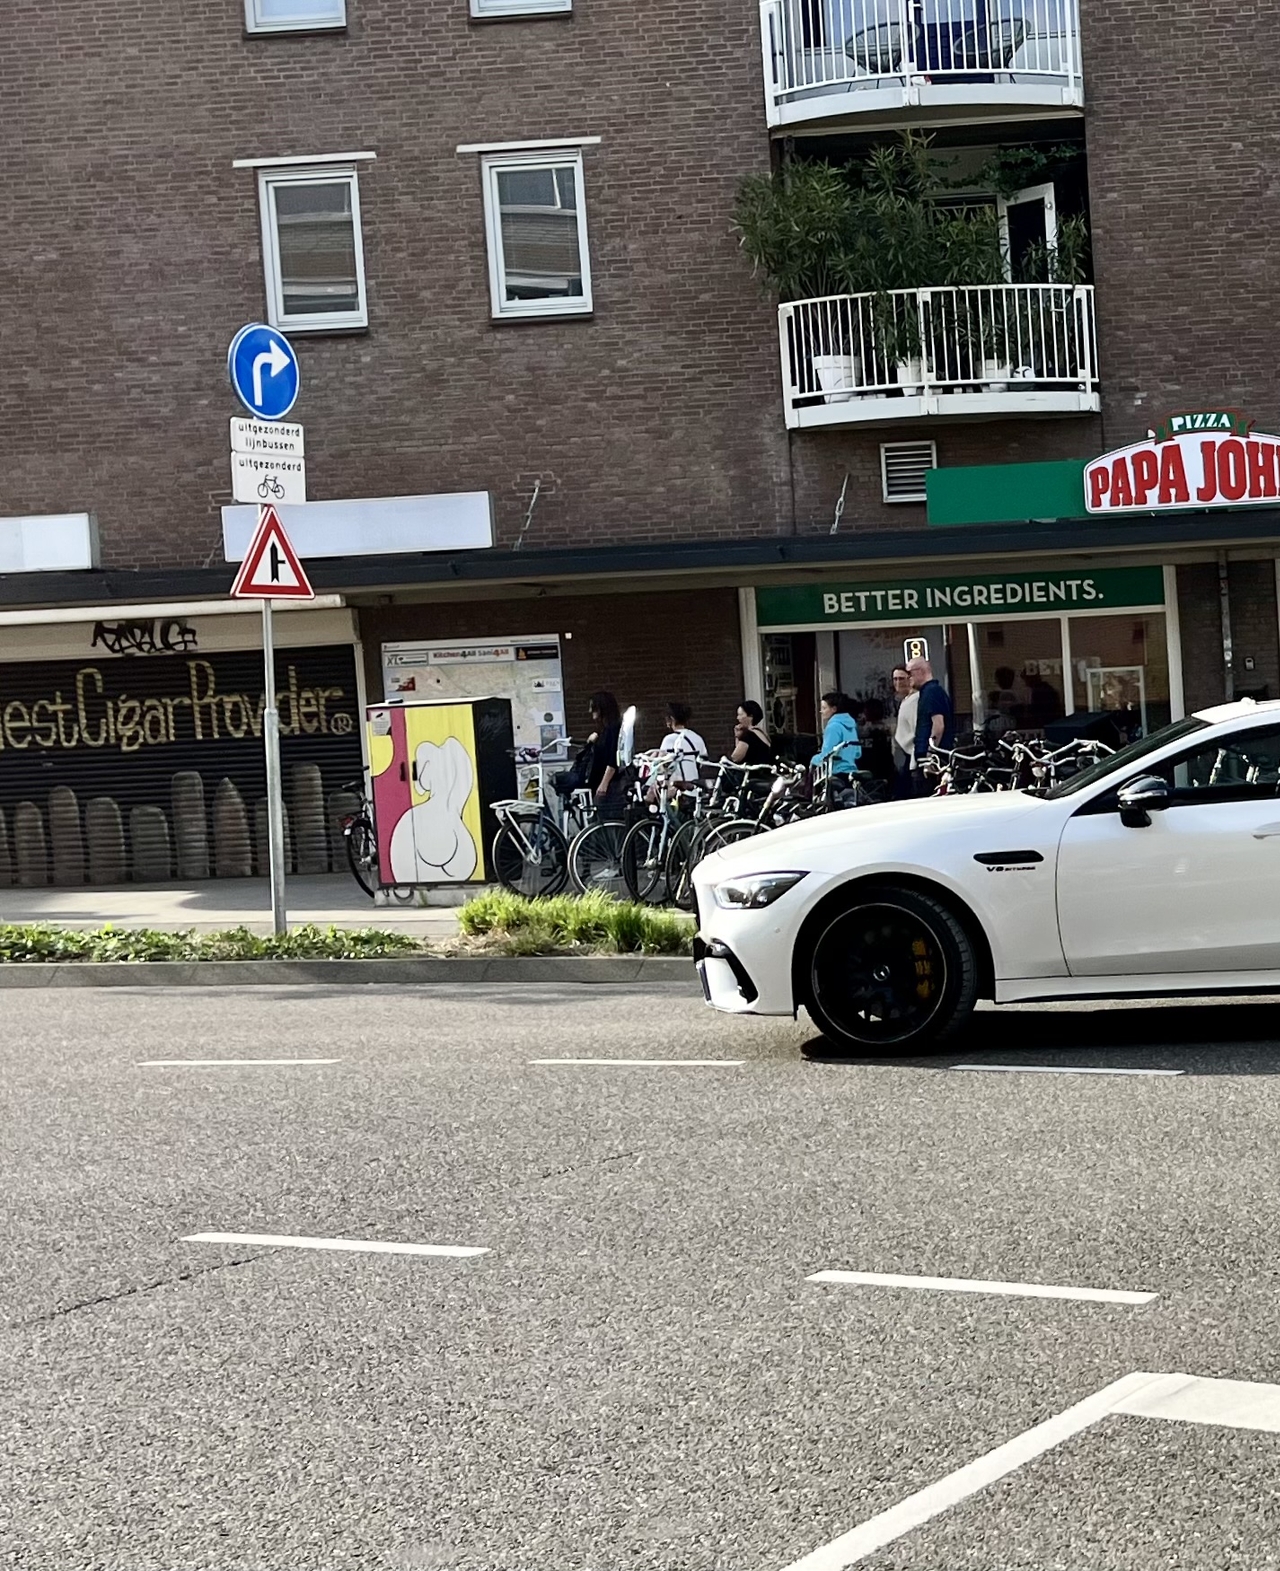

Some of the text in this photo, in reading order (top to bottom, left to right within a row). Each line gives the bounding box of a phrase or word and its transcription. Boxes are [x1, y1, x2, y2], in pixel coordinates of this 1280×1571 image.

[239, 423, 300, 437] uitgezonderd
[1171, 413, 1231, 431] PIZZA
[245, 437, 295, 450] lijnbussen
[239, 459, 301, 471] uitgezonderd
[1089, 444, 1190, 508] PAPA
[823, 579, 1104, 614] BETTER INGREDIENTS.
